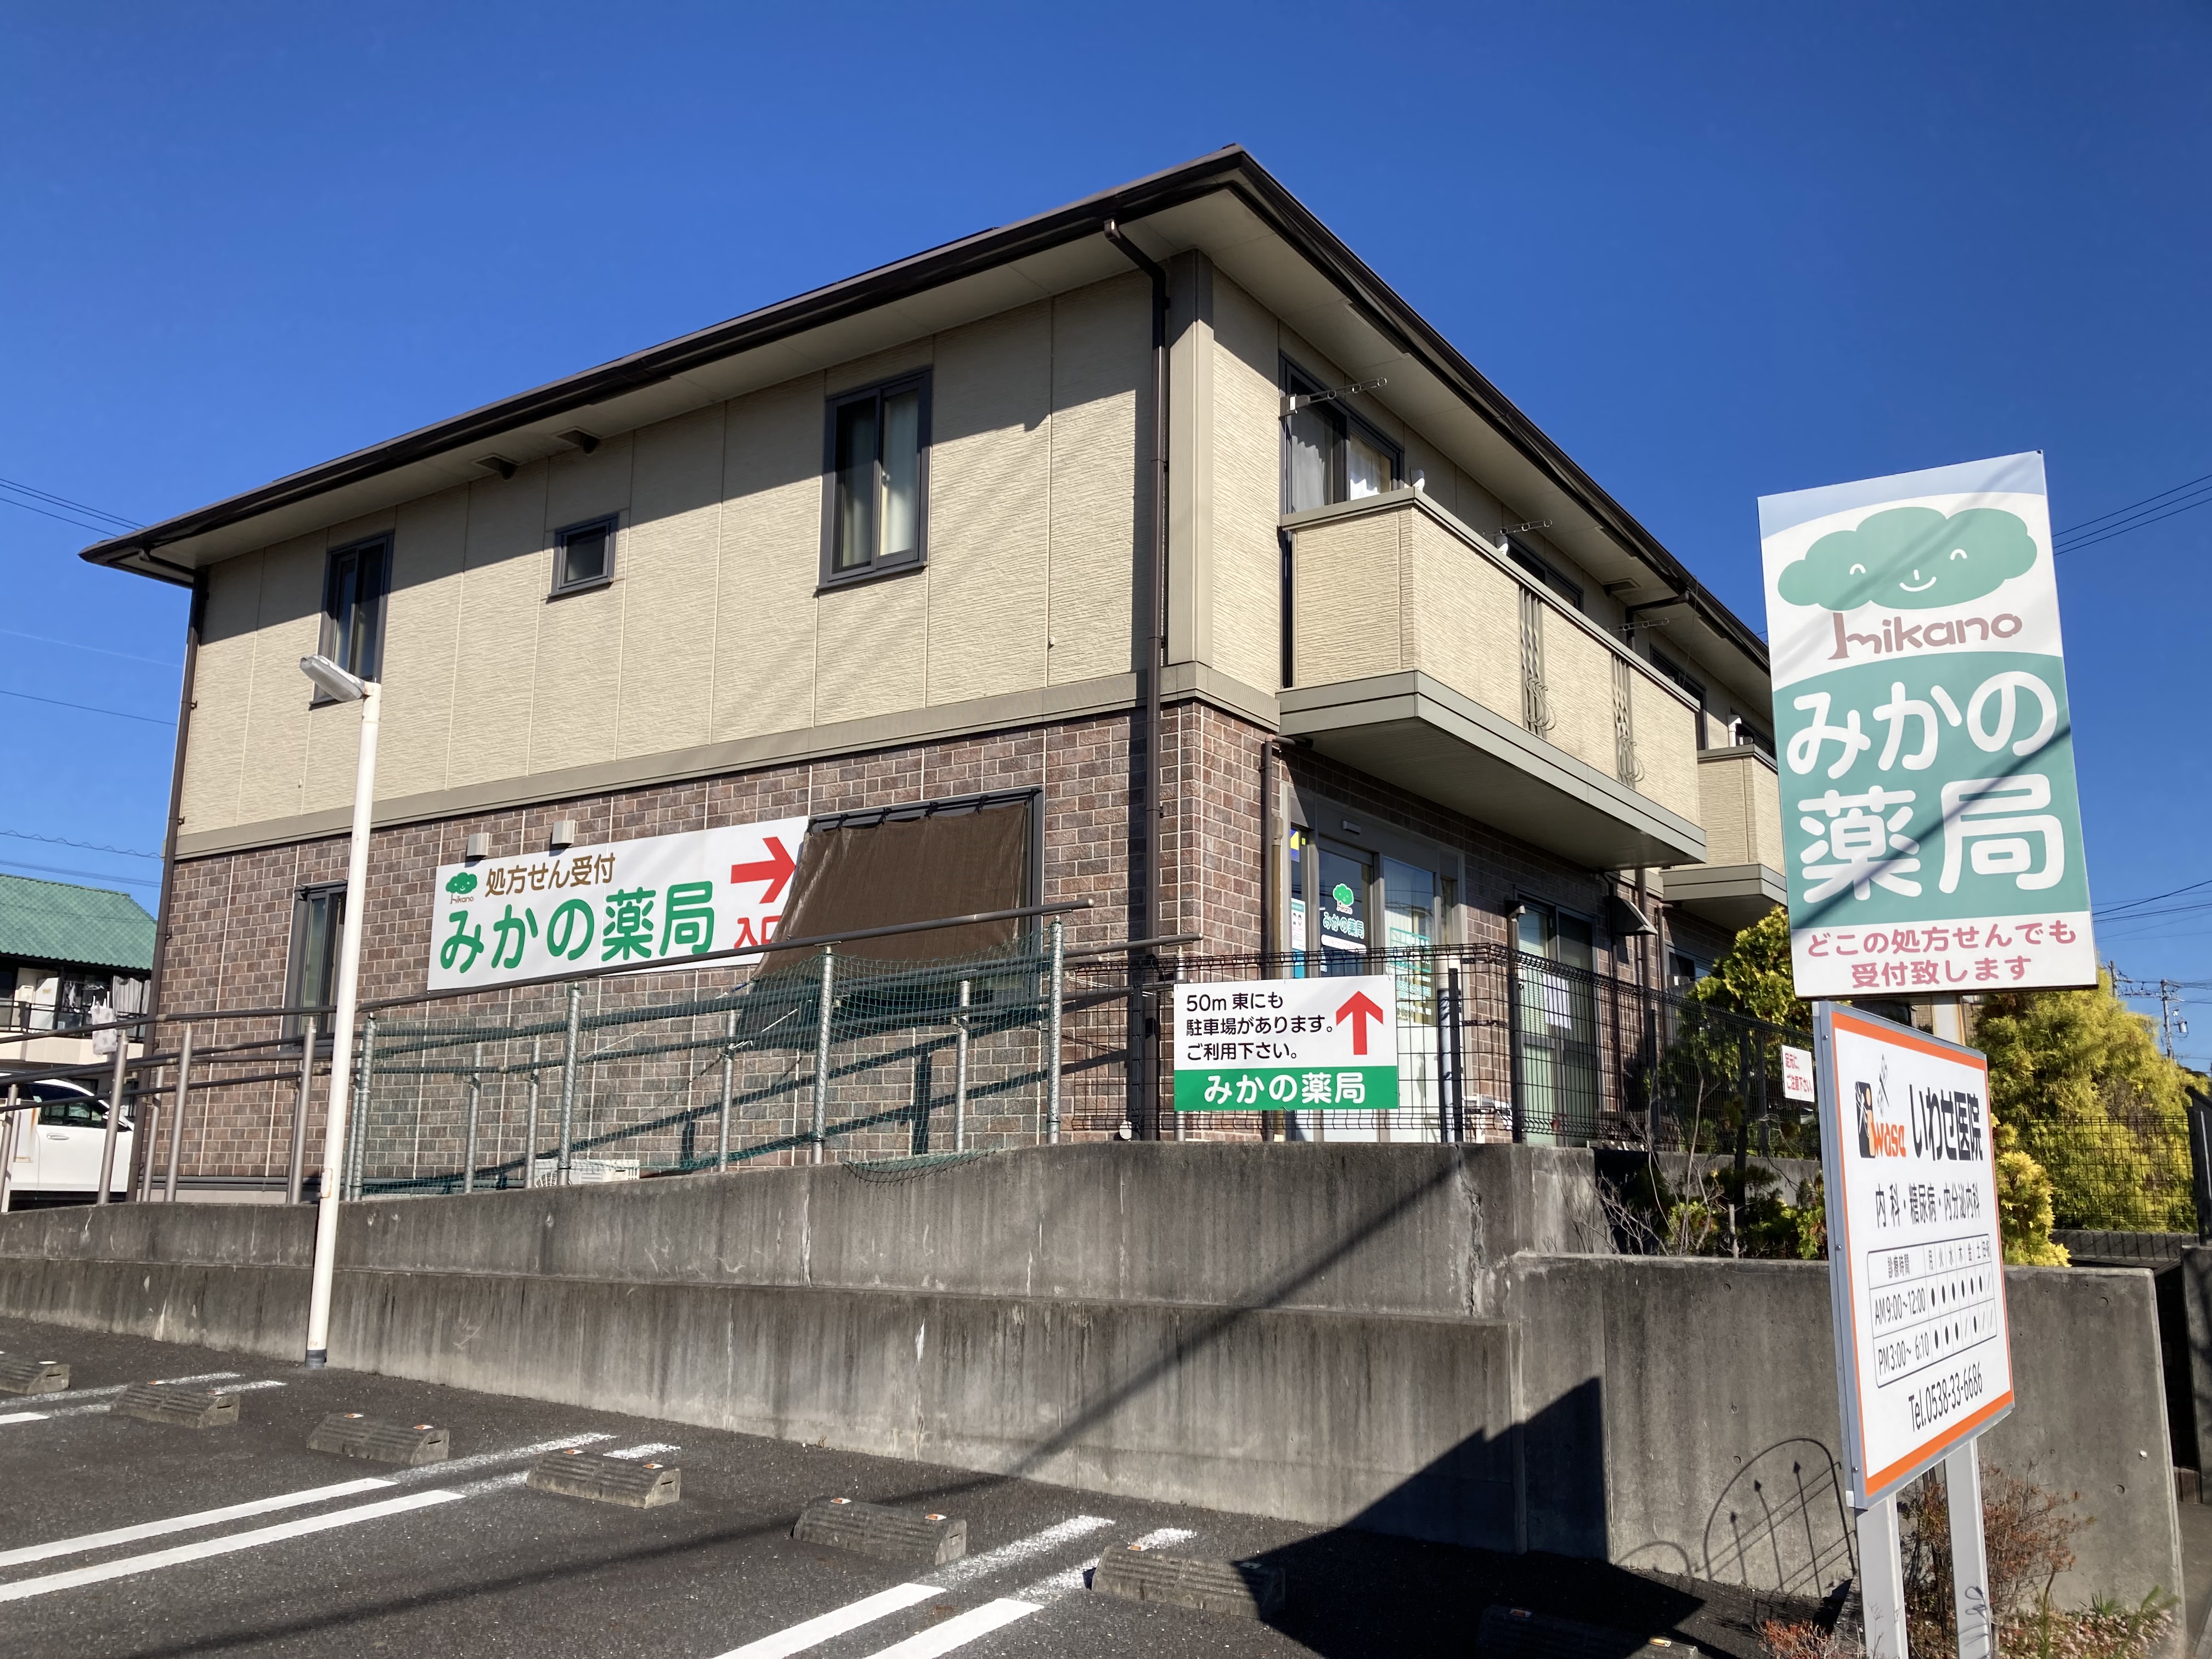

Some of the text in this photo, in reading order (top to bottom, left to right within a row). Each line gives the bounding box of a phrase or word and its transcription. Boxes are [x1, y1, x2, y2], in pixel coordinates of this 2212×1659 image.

[1787, 670, 2056, 779] みかの
[1797, 774, 2066, 904] 薬局
[485, 853, 615, 898] 処方せん受付
[441, 881, 714, 973] みかの薬局
[1323, 912, 1364, 939] みかの薬局
[1807, 920, 2076, 957] どこの処方せんでも
[1852, 955, 2032, 989] 受付致します
[1187, 992, 1283, 1011] 50m 東にも
[1187, 1015, 1333, 1036] 駐車場があります。
[1187, 1041, 1297, 1060] ご利用下さい。
[1205, 1072, 1365, 1104] みかの薬局
[1909, 1084, 1983, 1161] いわせ医院
[1928, 1250, 1933, 1271] 月
[1967, 1242, 1973, 1261] 金
